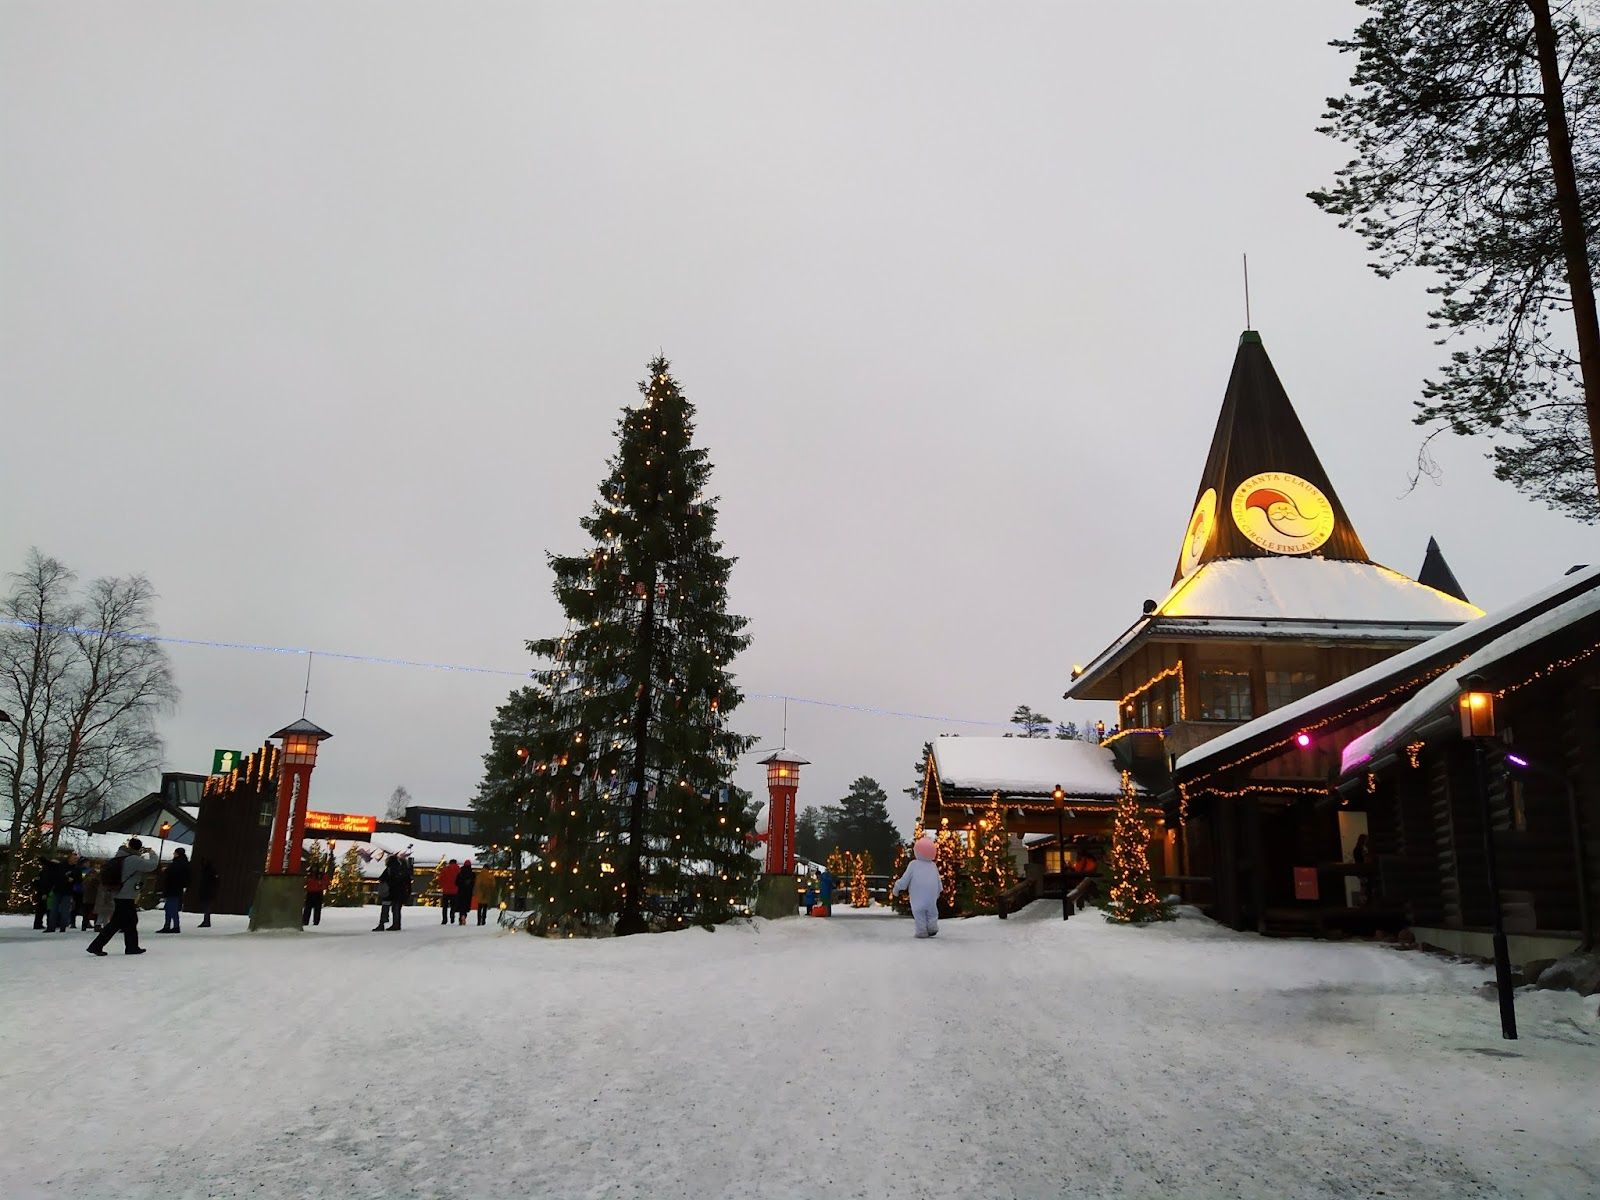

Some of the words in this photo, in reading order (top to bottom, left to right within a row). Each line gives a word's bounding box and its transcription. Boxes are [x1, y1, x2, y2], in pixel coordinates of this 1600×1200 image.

[1245, 475, 1280, 489] SANTA
[1284, 475, 1318, 496] CLAUS
[1242, 523, 1274, 549] CIRCLE
[1276, 536, 1321, 552] FINLAND
